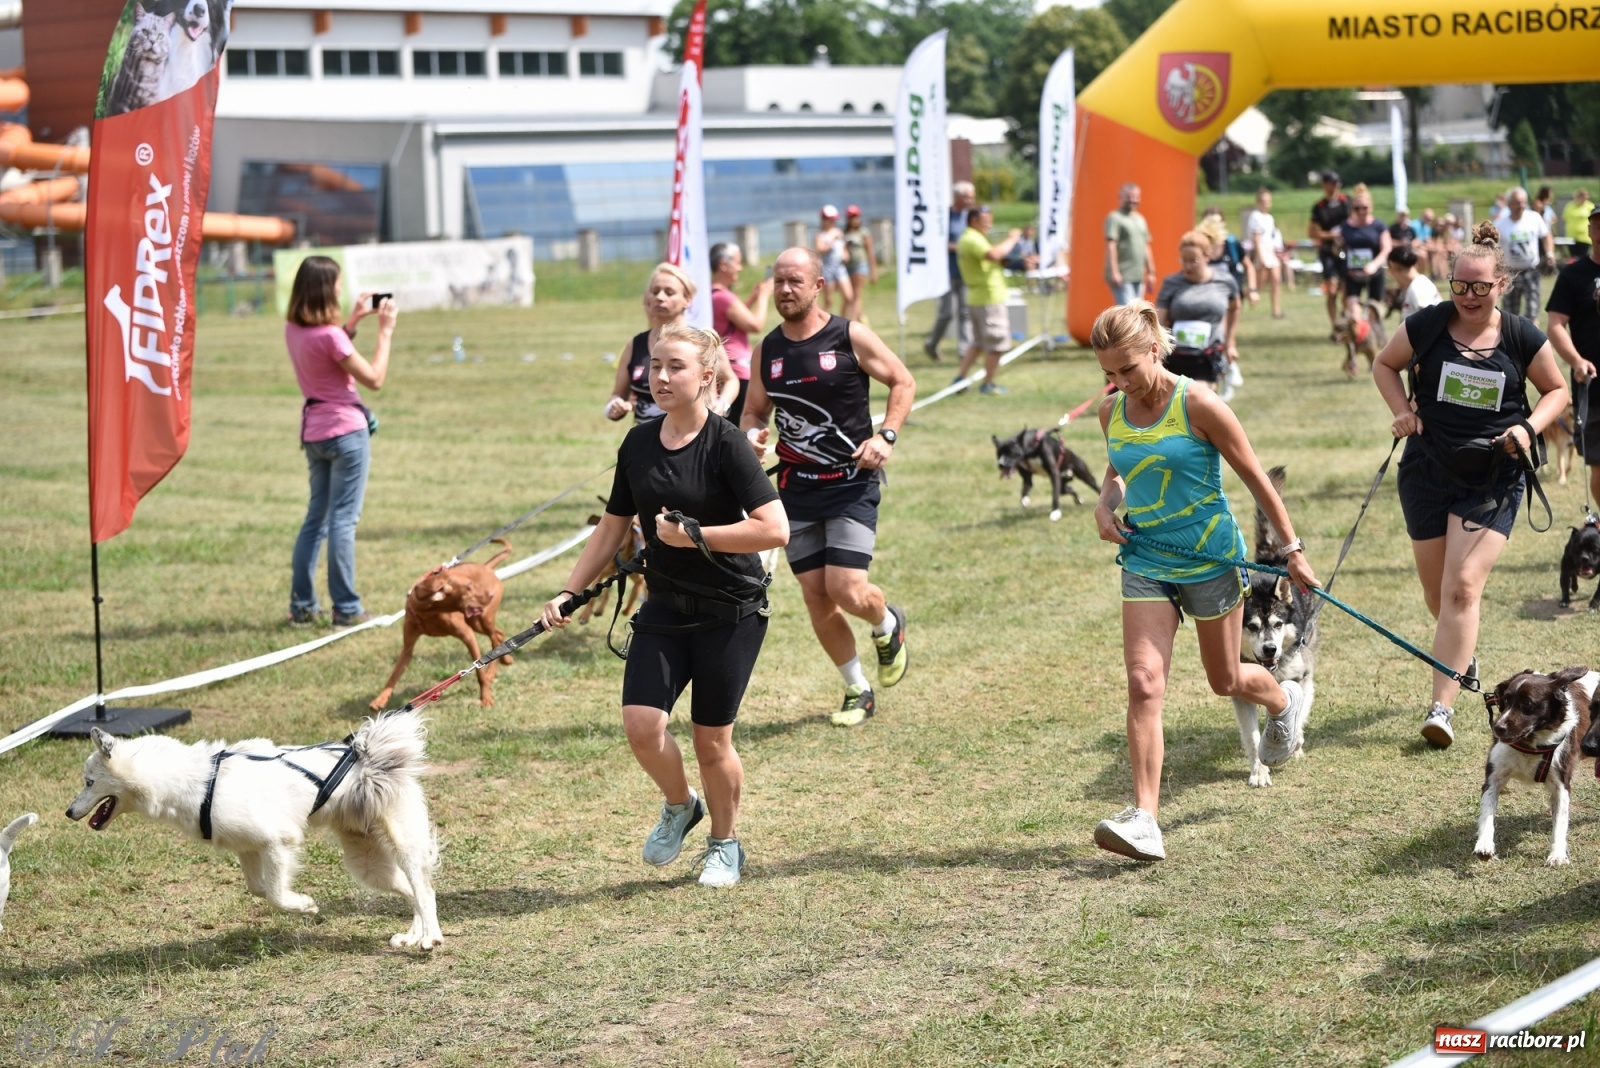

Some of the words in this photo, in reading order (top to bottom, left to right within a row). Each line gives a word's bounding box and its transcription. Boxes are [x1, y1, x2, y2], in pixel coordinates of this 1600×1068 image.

[1328, 14, 1442, 40] MIASTO
[1451, 2, 1600, 36] RACIBÓRZ
[906, 93, 928, 274] TropiDog
[1451, 371, 1497, 383] DOGTREKKING
[1460, 387, 1482, 400] 30
